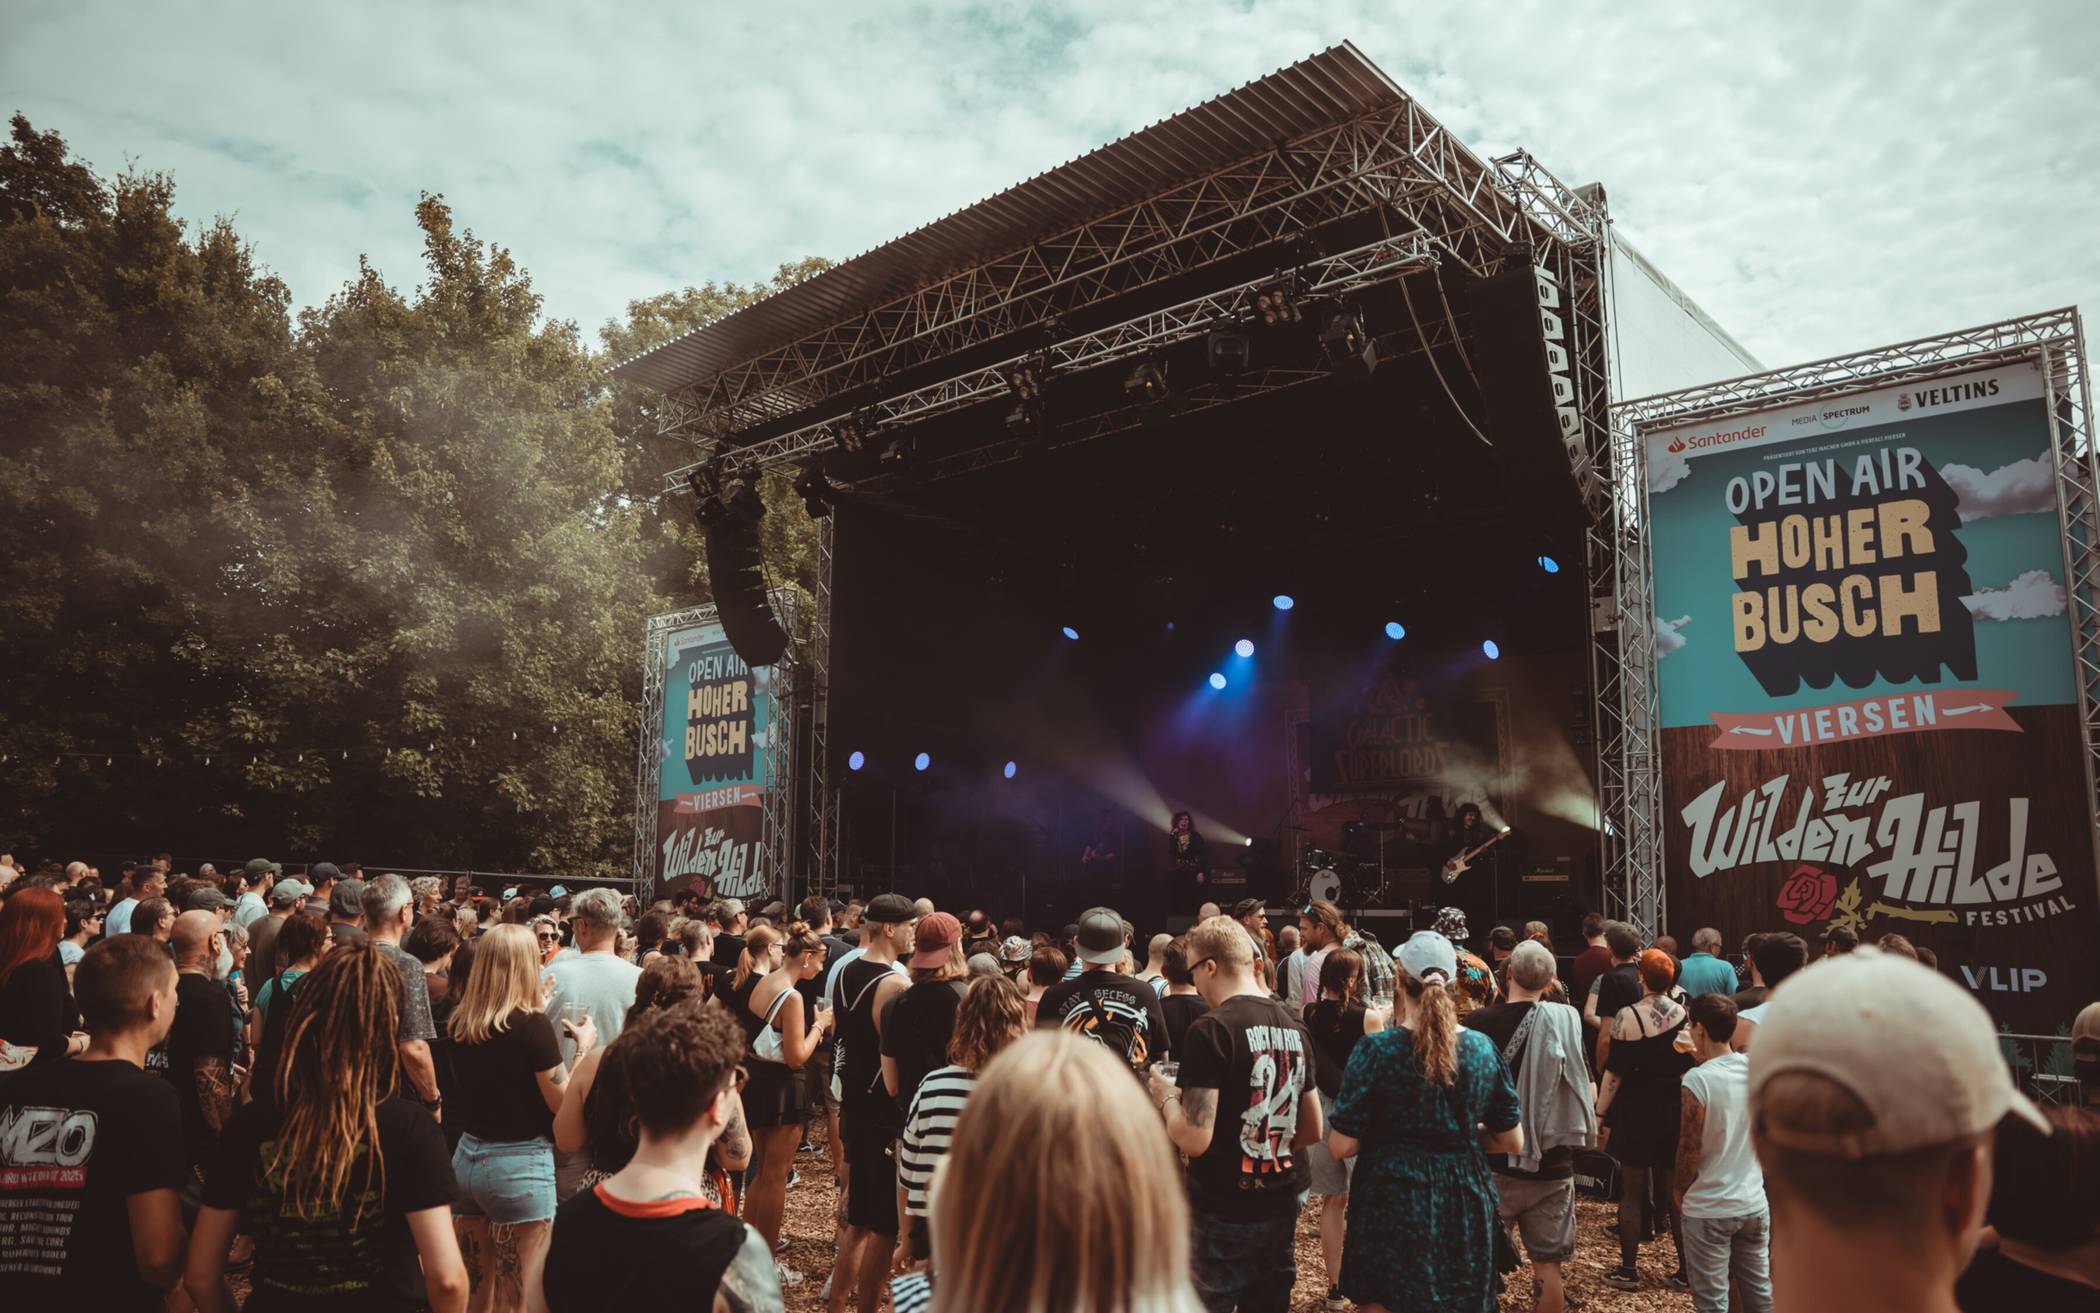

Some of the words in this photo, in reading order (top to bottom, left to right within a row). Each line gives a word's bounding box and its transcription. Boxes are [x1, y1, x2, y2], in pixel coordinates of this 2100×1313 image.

[1914, 378, 2000, 409] VELTINS
[1791, 415, 1818, 426] MEDIA
[1823, 405, 1870, 421] SPECTRUM
[1688, 424, 1767, 451] Santander
[1725, 457, 1837, 515] OPEN
[1851, 446, 1926, 497] AIR
[1730, 499, 1936, 580] HOHER
[1732, 570, 1941, 654] BUSCH
[688, 655, 723, 683] OPEN
[725, 654, 748, 678] AIR
[687, 680, 748, 720] HOHER
[1774, 694, 1937, 745] VIERSEN
[685, 720, 747, 761] BUSCH
[693, 786, 741, 812] VIERSEN
[1966, 895, 2076, 927] FESTIVAL
[1960, 965, 2047, 992] VLIP
[1246, 1024, 1271, 1053] ROCK
[1239, 1053, 1306, 1160] 24
